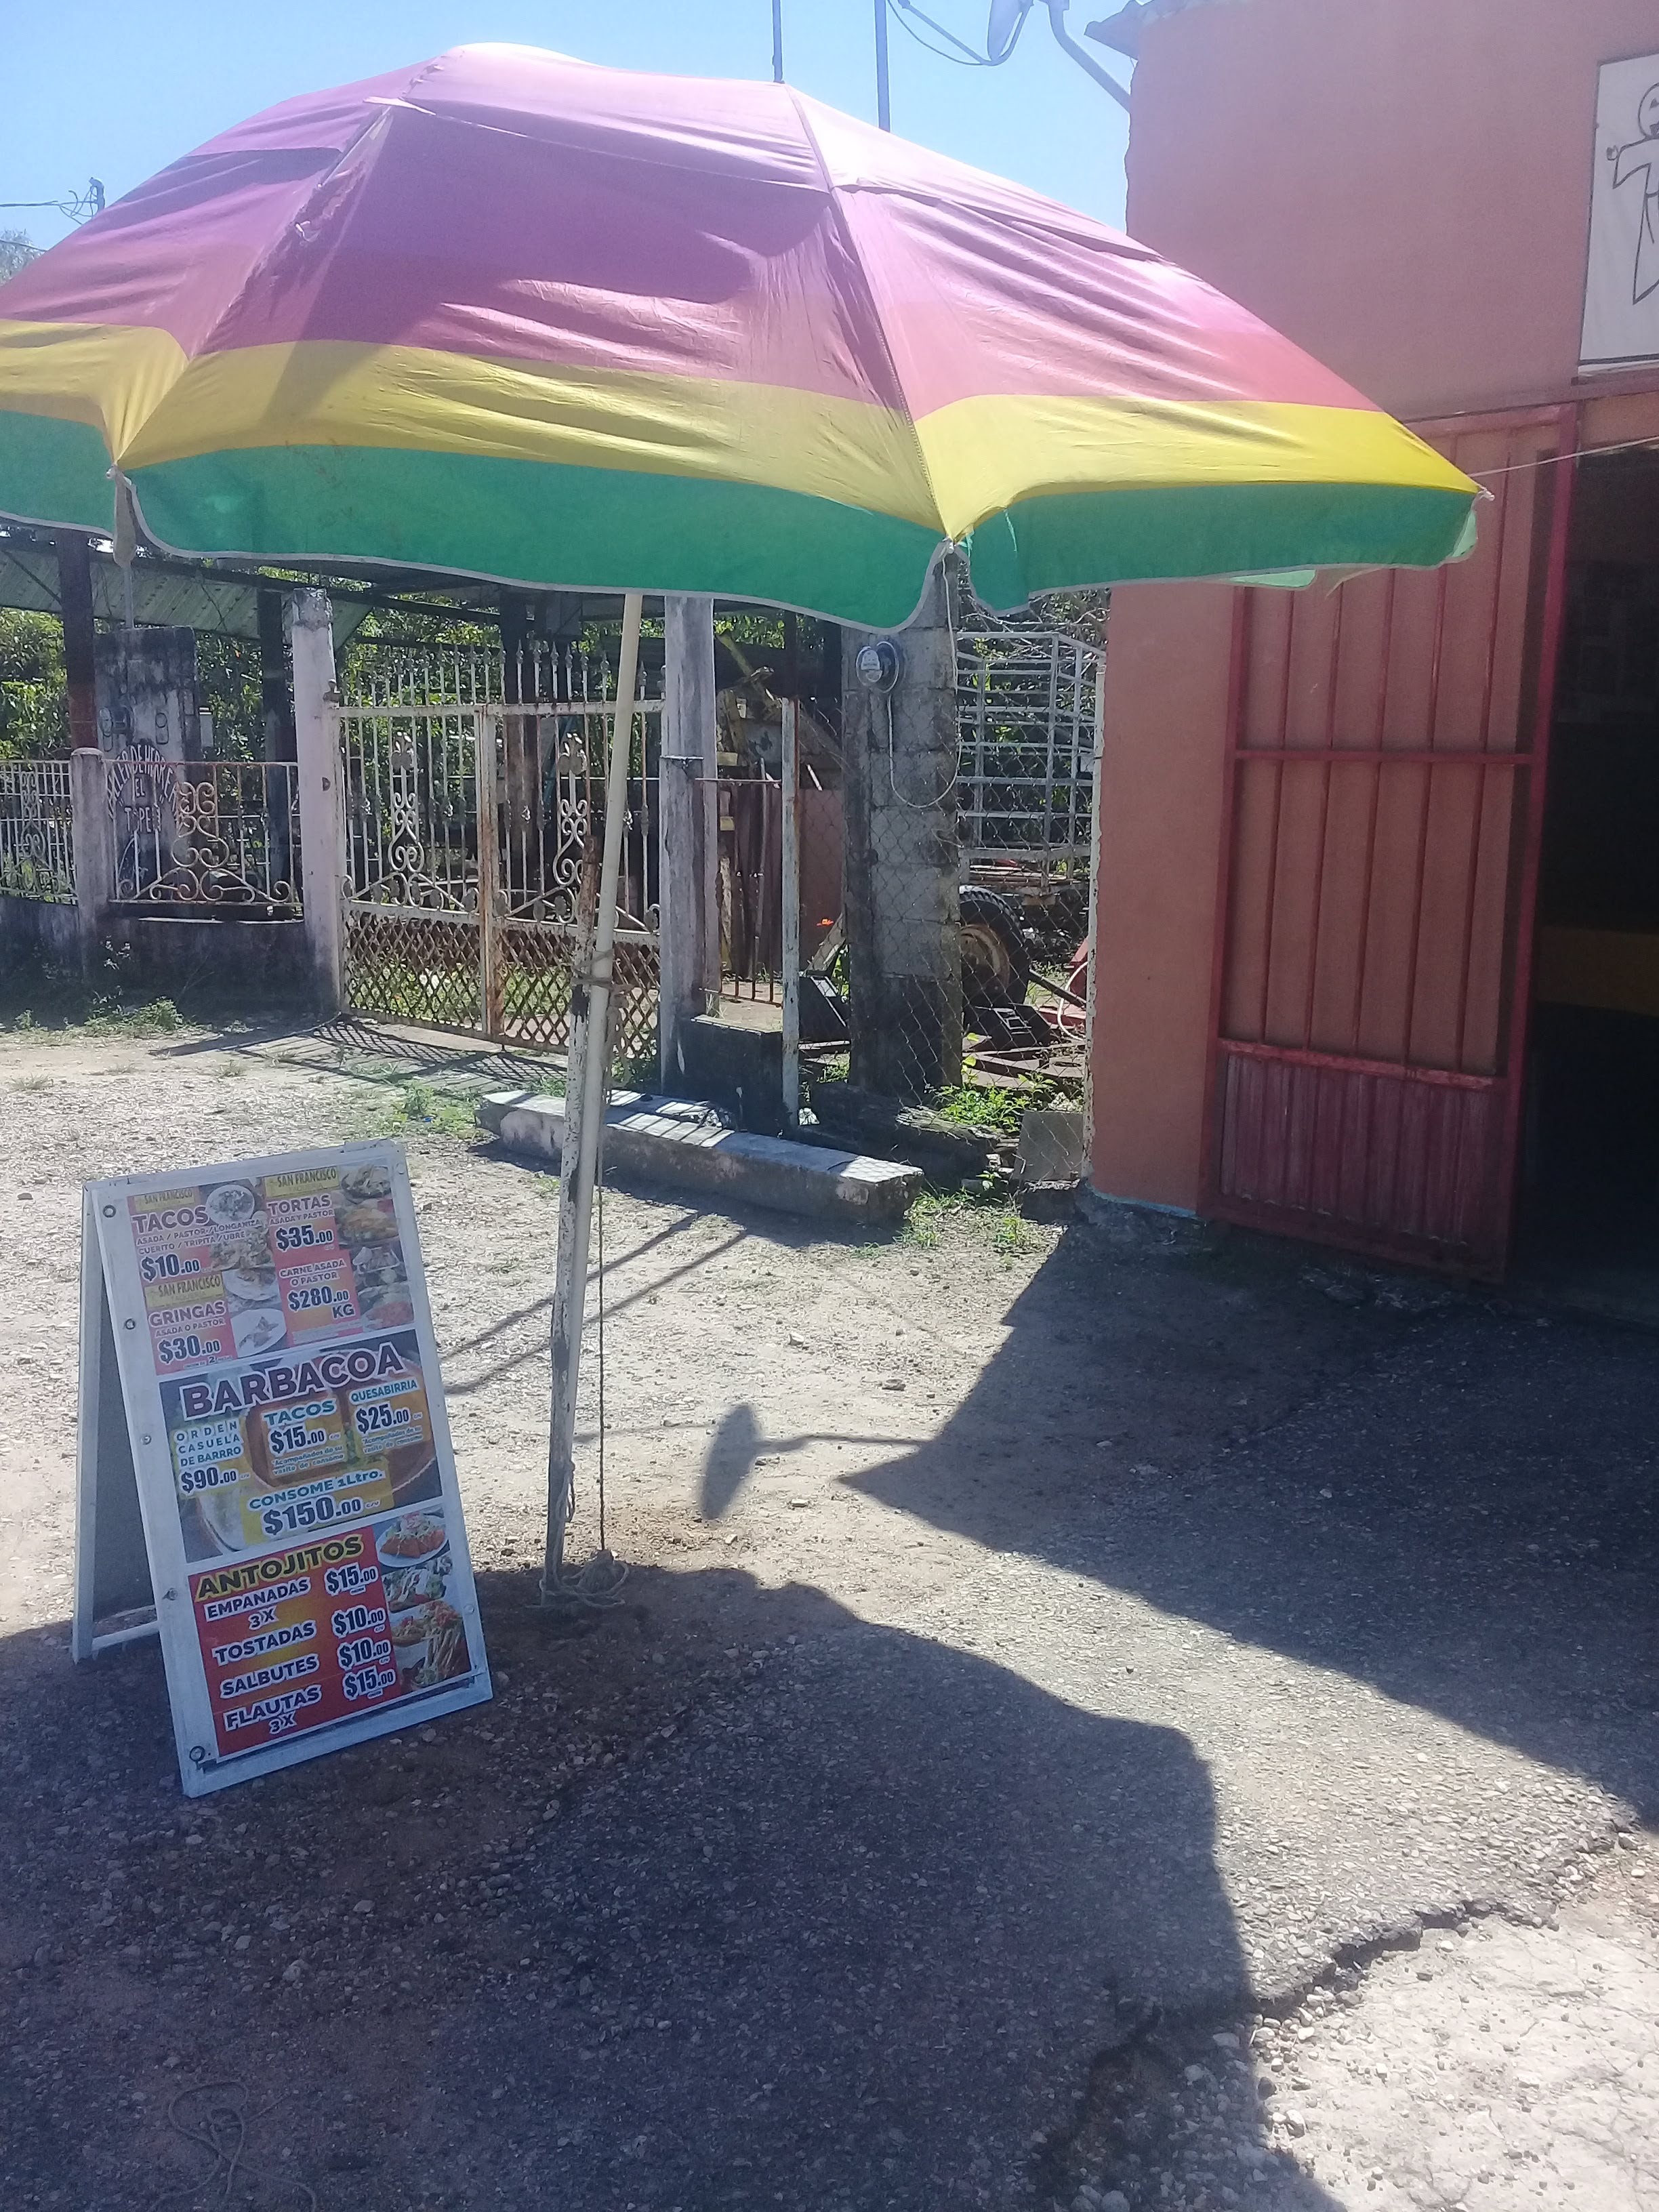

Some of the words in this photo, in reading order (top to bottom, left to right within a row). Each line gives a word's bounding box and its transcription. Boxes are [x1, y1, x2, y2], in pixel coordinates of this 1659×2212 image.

[136, 778, 145, 797] EL
[276, 1175, 293, 1187] SAN
[295, 1168, 336, 1185] FRANCISCO
[267, 1195, 331, 1215] TORTAS
[270, 1216, 295, 1225] ASADA
[303, 1209, 334, 1220] PASTOR
[131, 1206, 210, 1233] TACOS
[137, 1235, 164, 1246] ASADA
[138, 1244, 175, 1255] CUERITO
[184, 1237, 216, 1248] TRIPITA
[275, 1224, 333, 1251] $35.00
[141, 1254, 200, 1282] $10.00
[280, 1265, 312, 1277] CARNE
[314, 1259, 345, 1271] ASADA
[291, 1278, 298, 1286] O
[301, 1272, 337, 1284] PASTOR
[158, 1283, 176, 1297] SAN
[178, 1275, 221, 1294] FRANCISCO
[287, 1286, 349, 1311] $280.00
[149, 1301, 226, 1327] GRINGAS
[332, 1304, 355, 1319] KG
[156, 1324, 183, 1337] ASADA
[193, 1318, 224, 1330] PASTOR
[158, 1335, 220, 1364] $30.00
[184, 1346, 403, 1418] BARBACOA
[350, 1379, 417, 1403] QUESABIRRIA
[264, 1399, 335, 1426] TACOS
[356, 1404, 409, 1434] $25.00
[176, 1420, 237, 1441] ORDEN
[270, 1425, 325, 1454] $15.00
[178, 1434, 240, 1454] CASUELA
[180, 1456, 195, 1467] DE
[274, 1465, 295, 1475] vasito
[180, 1467, 237, 1494] $90.00
[249, 1480, 334, 1511] CONSOME
[263, 1497, 361, 1536] $150.00
[198, 1536, 361, 1599] ANTOJITOS
[207, 1579, 309, 1618] EMPANADAS
[326, 1565, 376, 1593] $15.00
[215, 1622, 314, 1663] TOSTADAS
[333, 1607, 384, 1635] $10.00
[222, 1656, 317, 1696] SALBUTES
[339, 1639, 389, 1667] $10.00
[226, 1687, 319, 1729] FLAUTAS
[344, 1668, 394, 1698] $15.00
